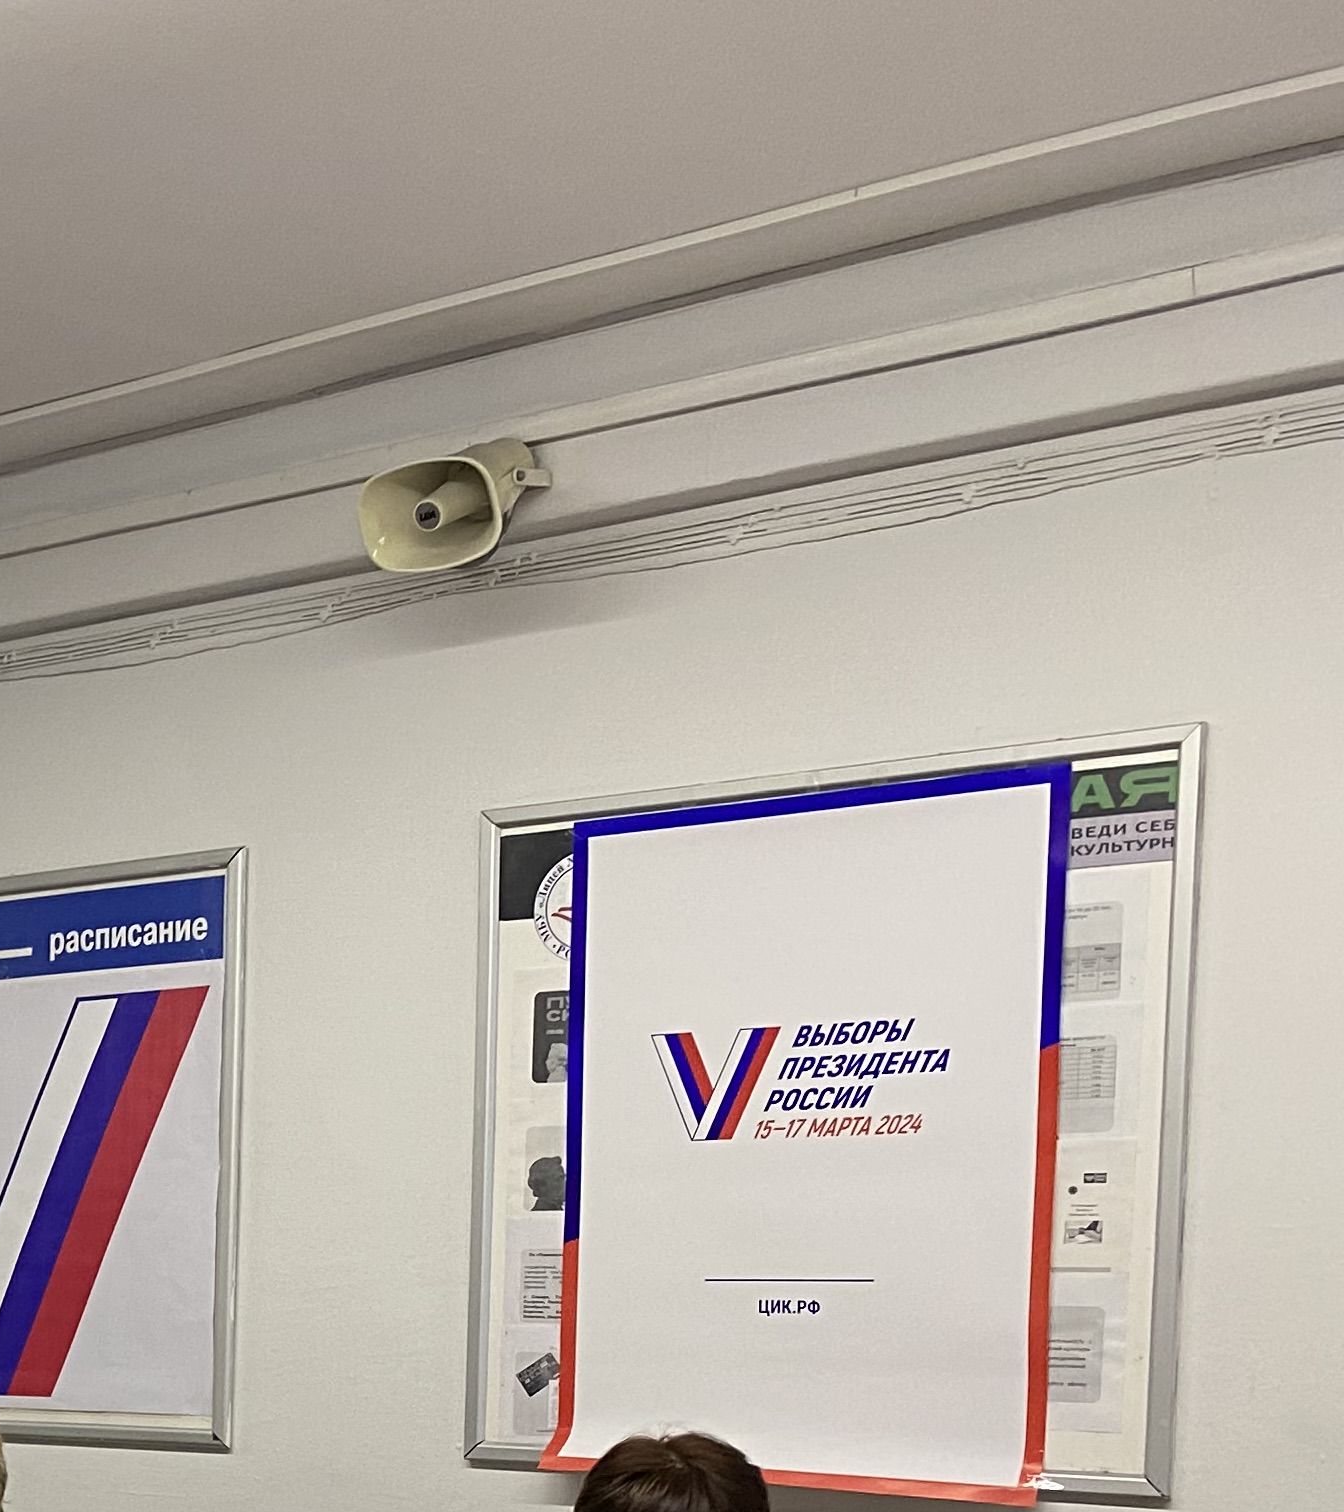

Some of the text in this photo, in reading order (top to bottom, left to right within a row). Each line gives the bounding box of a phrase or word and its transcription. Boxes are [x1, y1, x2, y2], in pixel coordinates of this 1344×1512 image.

[1071, 823, 1127, 839] ВЕДИ
[48, 916, 209, 962] расписание
[792, 1018, 915, 1048] ВЫБОРЫ
[777, 1048, 951, 1080] ПРЕЗИДЕНТА
[764, 1085, 873, 1112] РОССИИ
[807, 1116, 871, 1138] МАРТА
[874, 1113, 924, 1136] 2024
[758, 1299, 821, 1316] ЦИК.РФ
